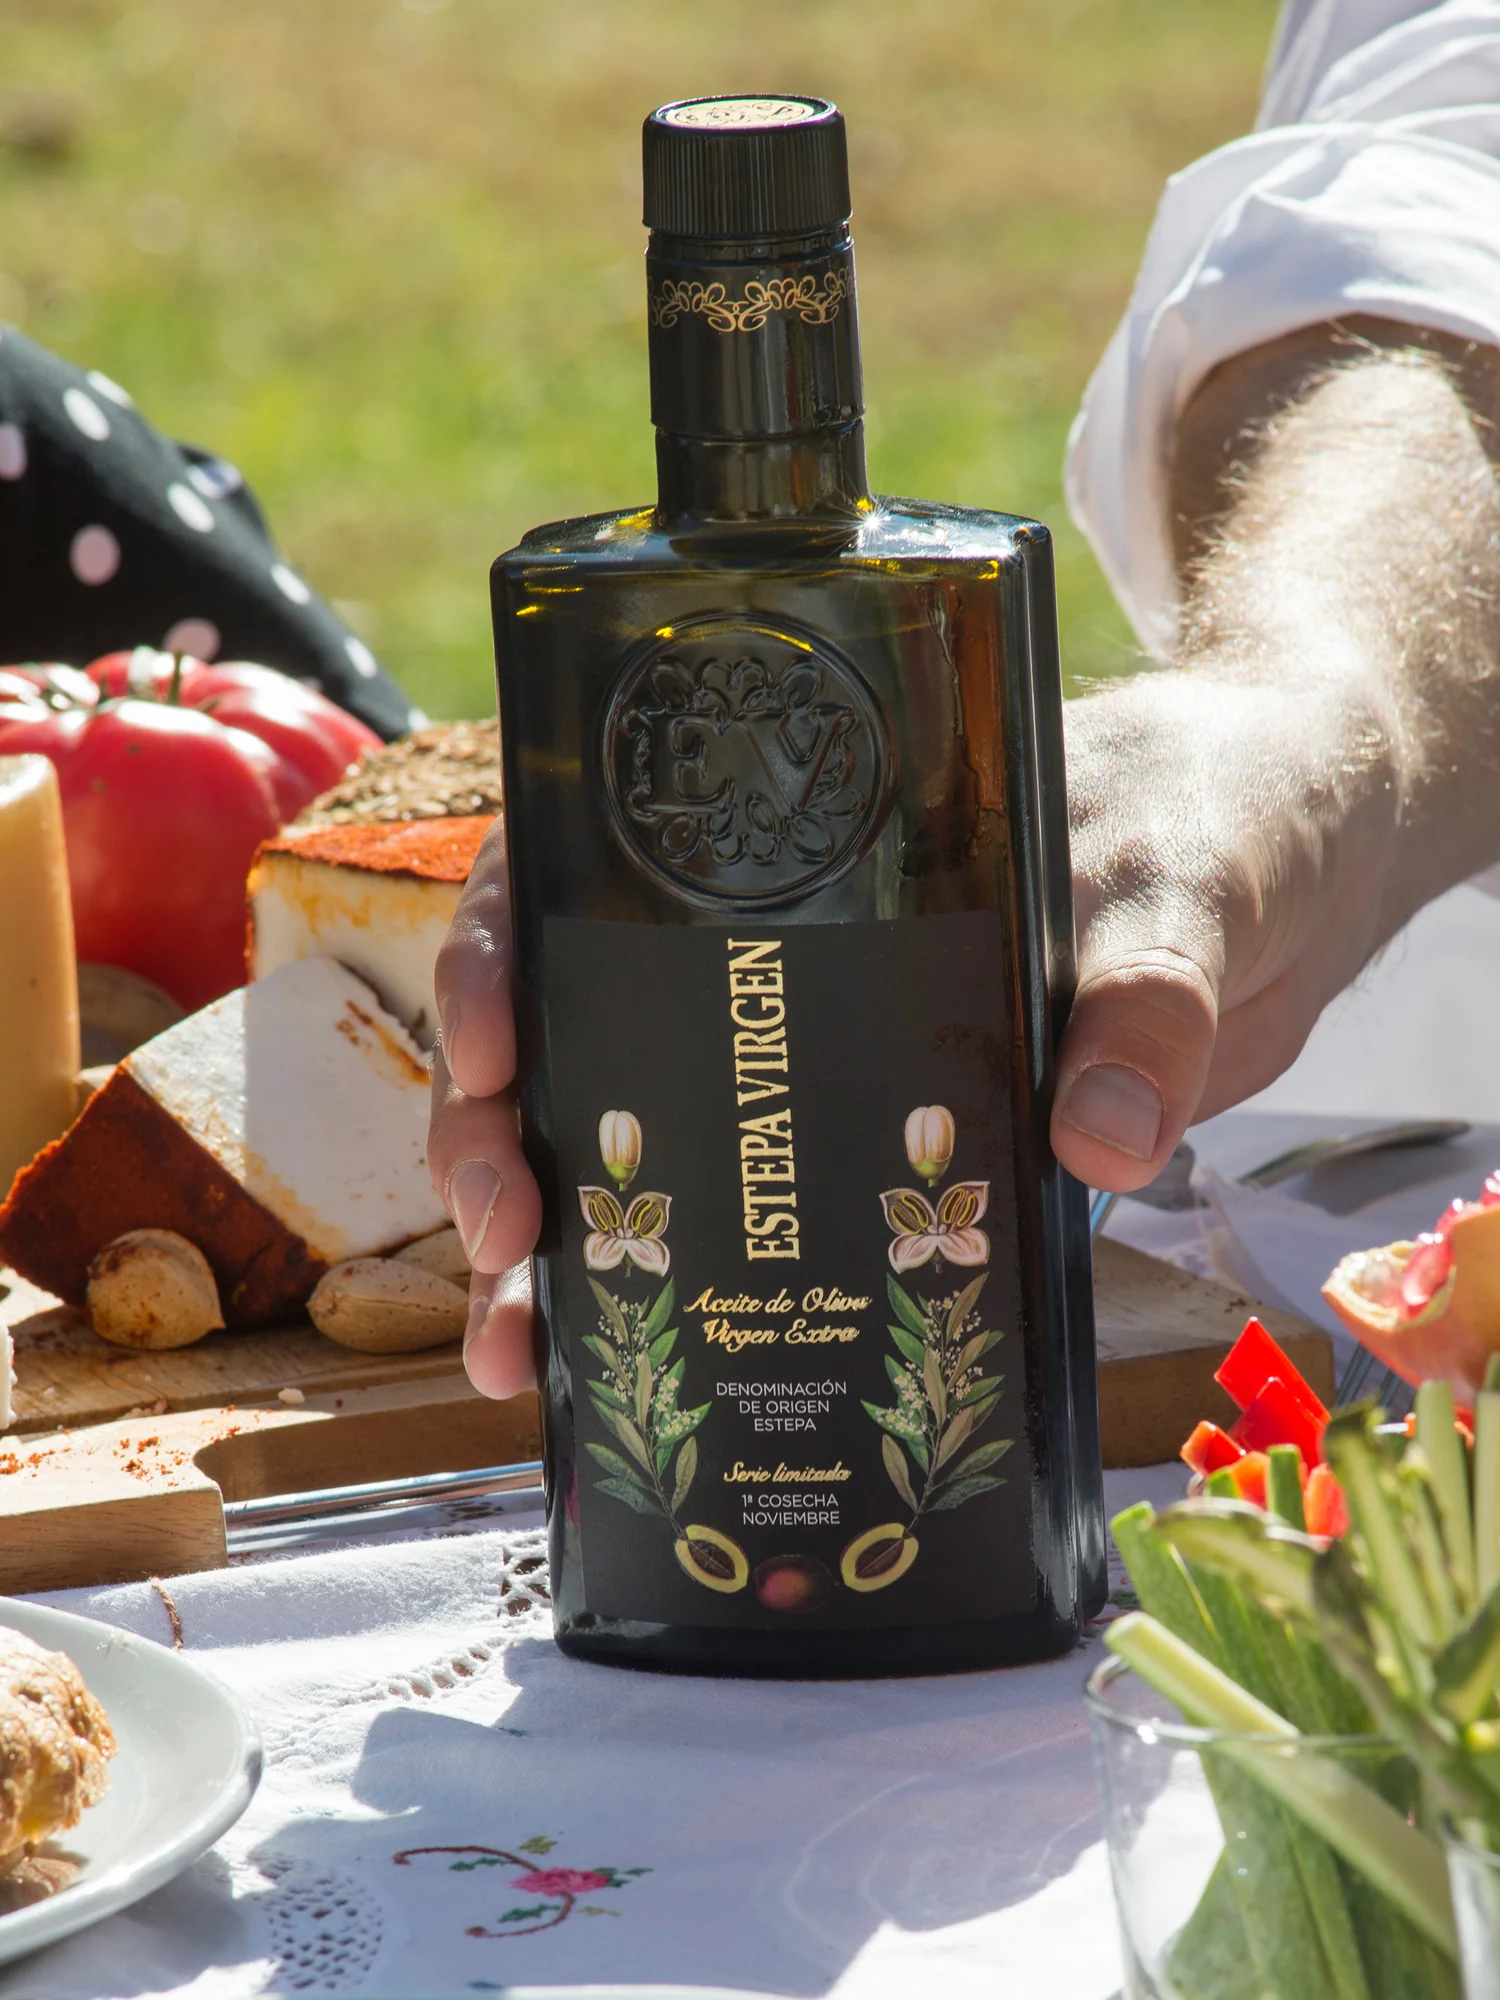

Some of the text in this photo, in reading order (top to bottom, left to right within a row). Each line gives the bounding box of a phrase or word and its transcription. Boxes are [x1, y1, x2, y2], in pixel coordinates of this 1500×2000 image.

[727, 938, 801, 1261] ESTEPA VIRGEN
[683, 1286, 873, 1314] Aceite de Oliva
[702, 1318, 861, 1353] Virgen Extra
[716, 1379, 848, 1397] DENOMINACIÓN
[739, 1400, 830, 1414] DE ORIGEN
[754, 1418, 817, 1432] ESTEPA
[723, 1461, 852, 1482] Serie limitada
[758, 1494, 839, 1508] COSECHA
[743, 1511, 841, 1525] NOVIEMBRE
